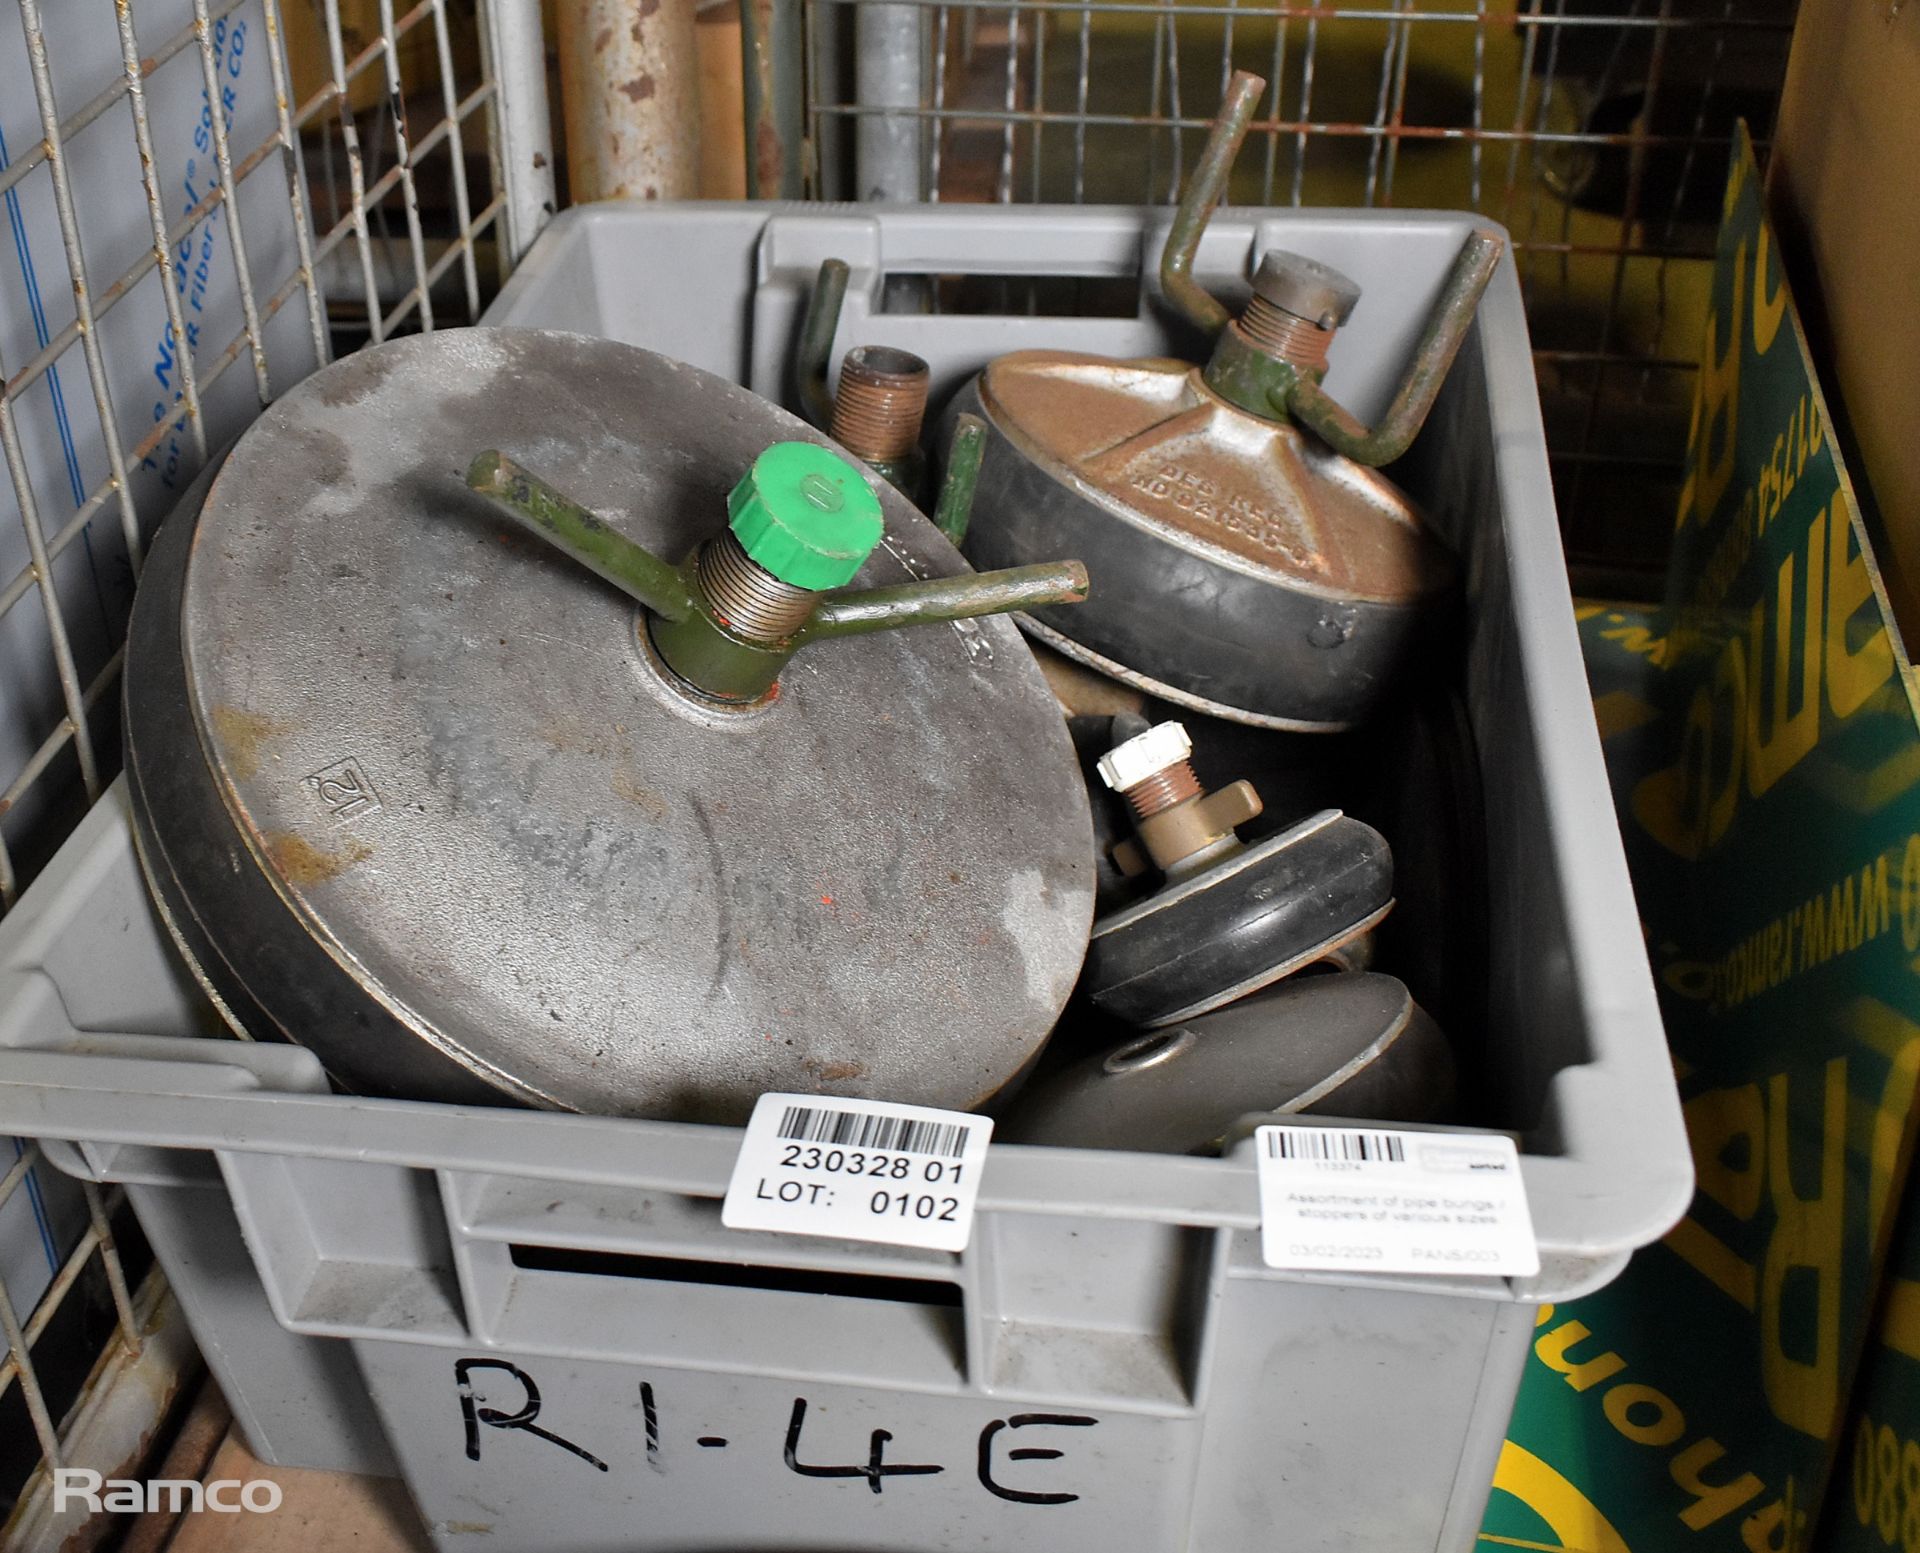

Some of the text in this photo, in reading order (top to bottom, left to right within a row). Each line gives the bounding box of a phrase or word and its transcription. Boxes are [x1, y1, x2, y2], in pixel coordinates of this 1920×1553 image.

[190, 223, 213, 313] Fiber
[780, 1145, 963, 1185] 230328 01
[757, 1178, 959, 1222] LOT: 0102
[1287, 1192, 1377, 1206] Assortment
[1383, 1193, 1398, 1206] of
[1404, 1197, 1438, 1210] pipe
[1442, 1198, 1495, 1212] bungs
[1297, 1208, 1499, 1224] stoppers of various sizes
